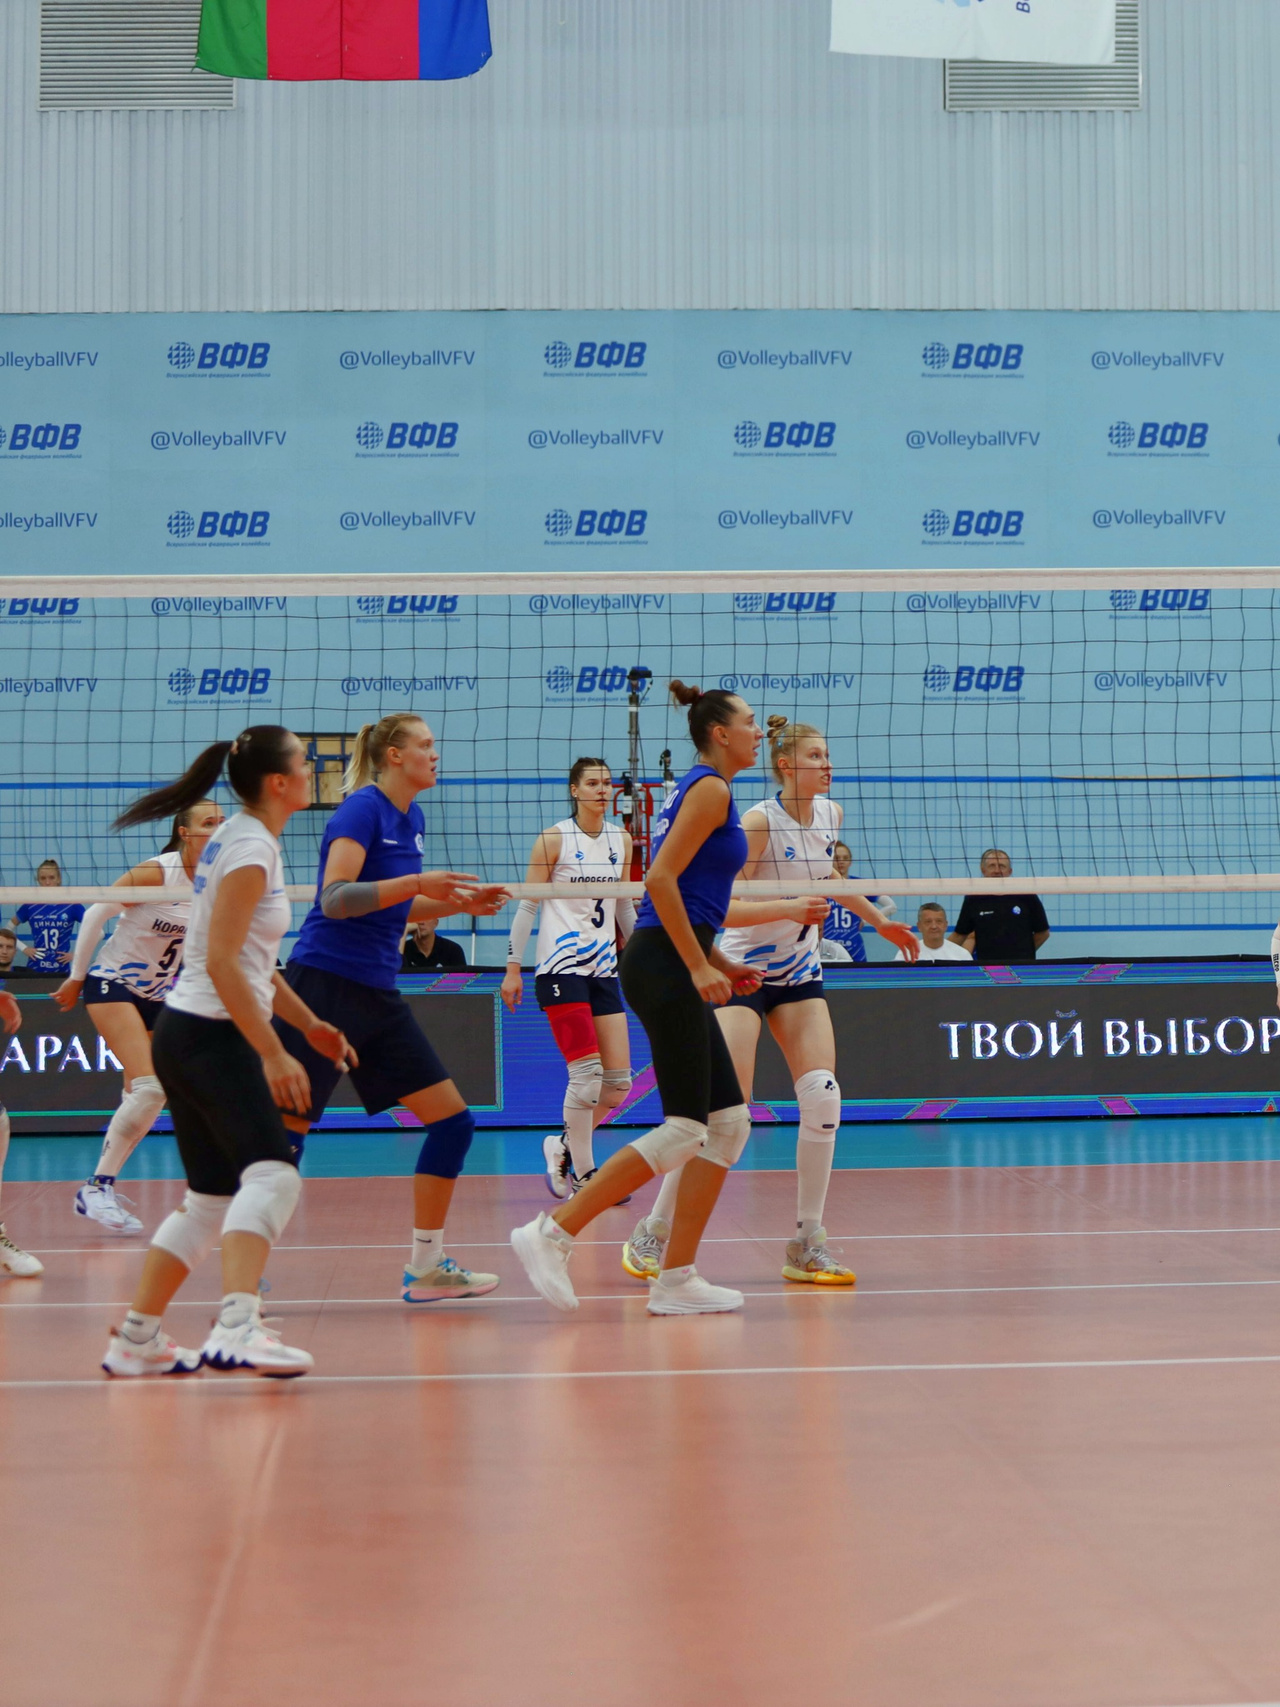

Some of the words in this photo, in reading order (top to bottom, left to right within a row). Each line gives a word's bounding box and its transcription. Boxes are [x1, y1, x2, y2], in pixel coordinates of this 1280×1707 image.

[197, 342, 271, 369] ВФВ
[340, 350, 475, 370] @VolleyballVFV
[574, 341, 647, 368] ВФВ
[717, 350, 852, 369] @VolleyballVFV
[952, 342, 1024, 370] ВФВ
[1091, 351, 1224, 370] @VolleyballVFV
[9, 423, 82, 450] ВФВ
[151, 430, 286, 450] @VolleyballVFV
[386, 421, 459, 449] ВФВ
[528, 429, 664, 449] @VolleyballVFV
[764, 421, 837, 448] ВФВ
[906, 430, 1040, 450] @VolleyballVFV
[1138, 421, 1210, 449] ВФВ
[197, 510, 270, 538] ВФВ
[340, 510, 476, 531] @VolleyballVFV
[575, 509, 648, 537] ВФВ
[718, 509, 853, 529] @VolleyballVFV
[953, 509, 1025, 537] ВФВ
[1093, 509, 1226, 529] @VolleyballVFV
[151, 596, 286, 615] @VolleyballVFV
[529, 594, 665, 613] @VolleyballVFV
[906, 593, 1040, 613] @VolleyballVFV
[1139, 589, 1211, 612] ВФВ
[198, 667, 271, 695] ВФВ
[341, 675, 477, 696] @VolleyballVFV
[719, 673, 854, 693] @VolleyballVFV
[954, 664, 1026, 692] ВФВ
[1095, 672, 1228, 692] @VolleyballVFV
[591, 899, 605, 928] 3
[832, 907, 852, 928] 15
[152, 918, 188, 934] КОРА
[42, 928, 59, 950] 13
[158, 938, 184, 970] 5
[101, 981, 109, 994] 5
[552, 984, 561, 997] 3
[938, 1009, 1084, 1060] ТВОЙ
